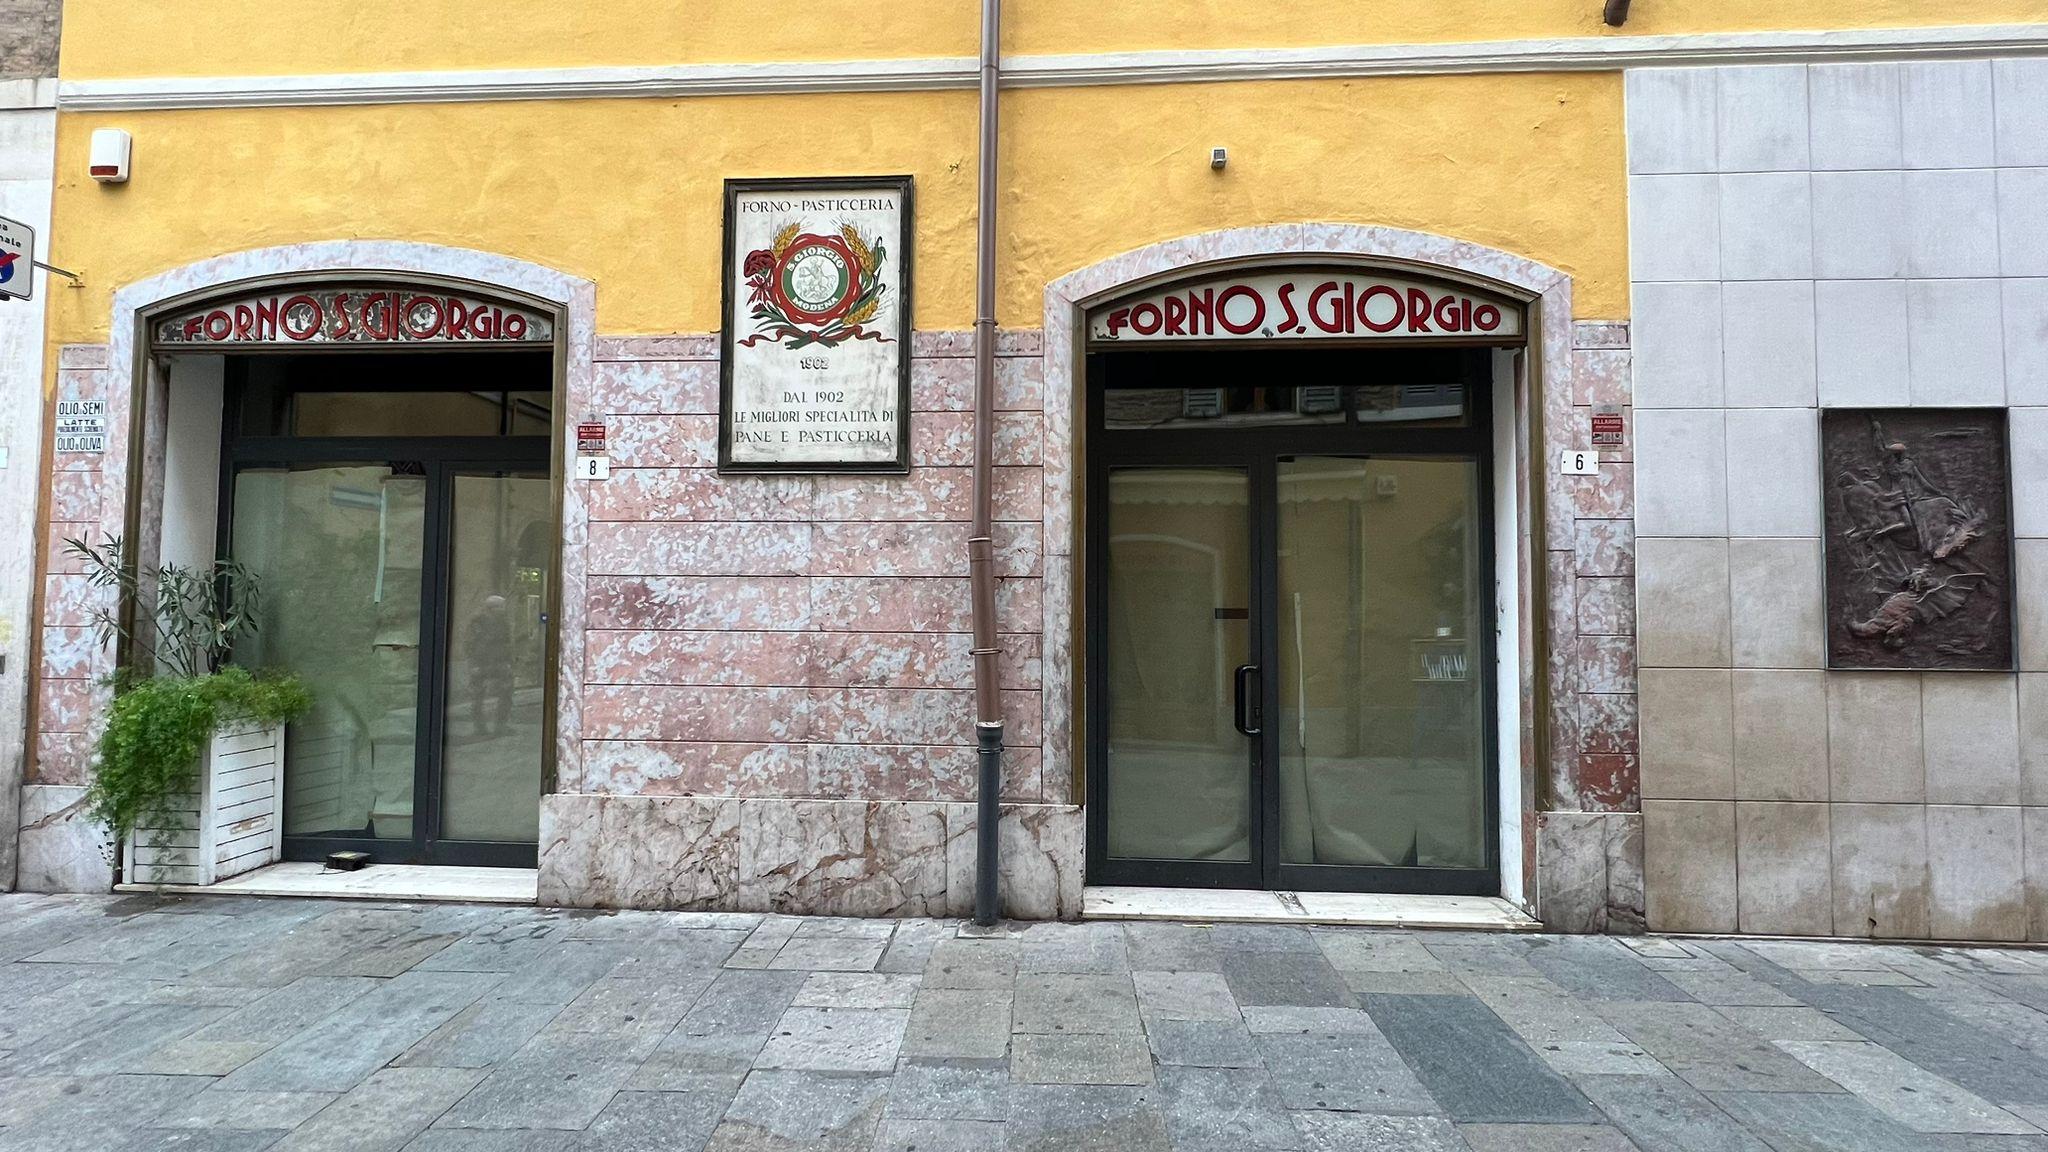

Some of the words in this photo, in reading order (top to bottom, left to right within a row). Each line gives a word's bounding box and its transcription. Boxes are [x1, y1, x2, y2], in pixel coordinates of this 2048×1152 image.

[742, 201, 791, 213] FORNO
[802, 199, 894, 212] PASTICCERIA
[792, 296, 839, 311] MODENA
[1106, 284, 1266, 336] FORNO
[183, 295, 323, 341] FORNO
[800, 357, 831, 370] 1902
[783, 391, 807, 403] DAL
[815, 391, 844, 403] 1902
[59, 402, 79, 415] OLIO
[82, 402, 104, 415] SEMI
[734, 411, 747, 423] LE
[750, 411, 800, 423] MIGLIORI
[882, 410, 894, 422] DI
[735, 430, 772, 443] PANE
[781, 431, 789, 443] E
[798, 430, 892, 443] PASTICCERIA
[57, 437, 75, 450] OLIO
[80, 437, 102, 450] OLIVA
[589, 459, 597, 475] 8
[1576, 454, 1584, 471] 6
